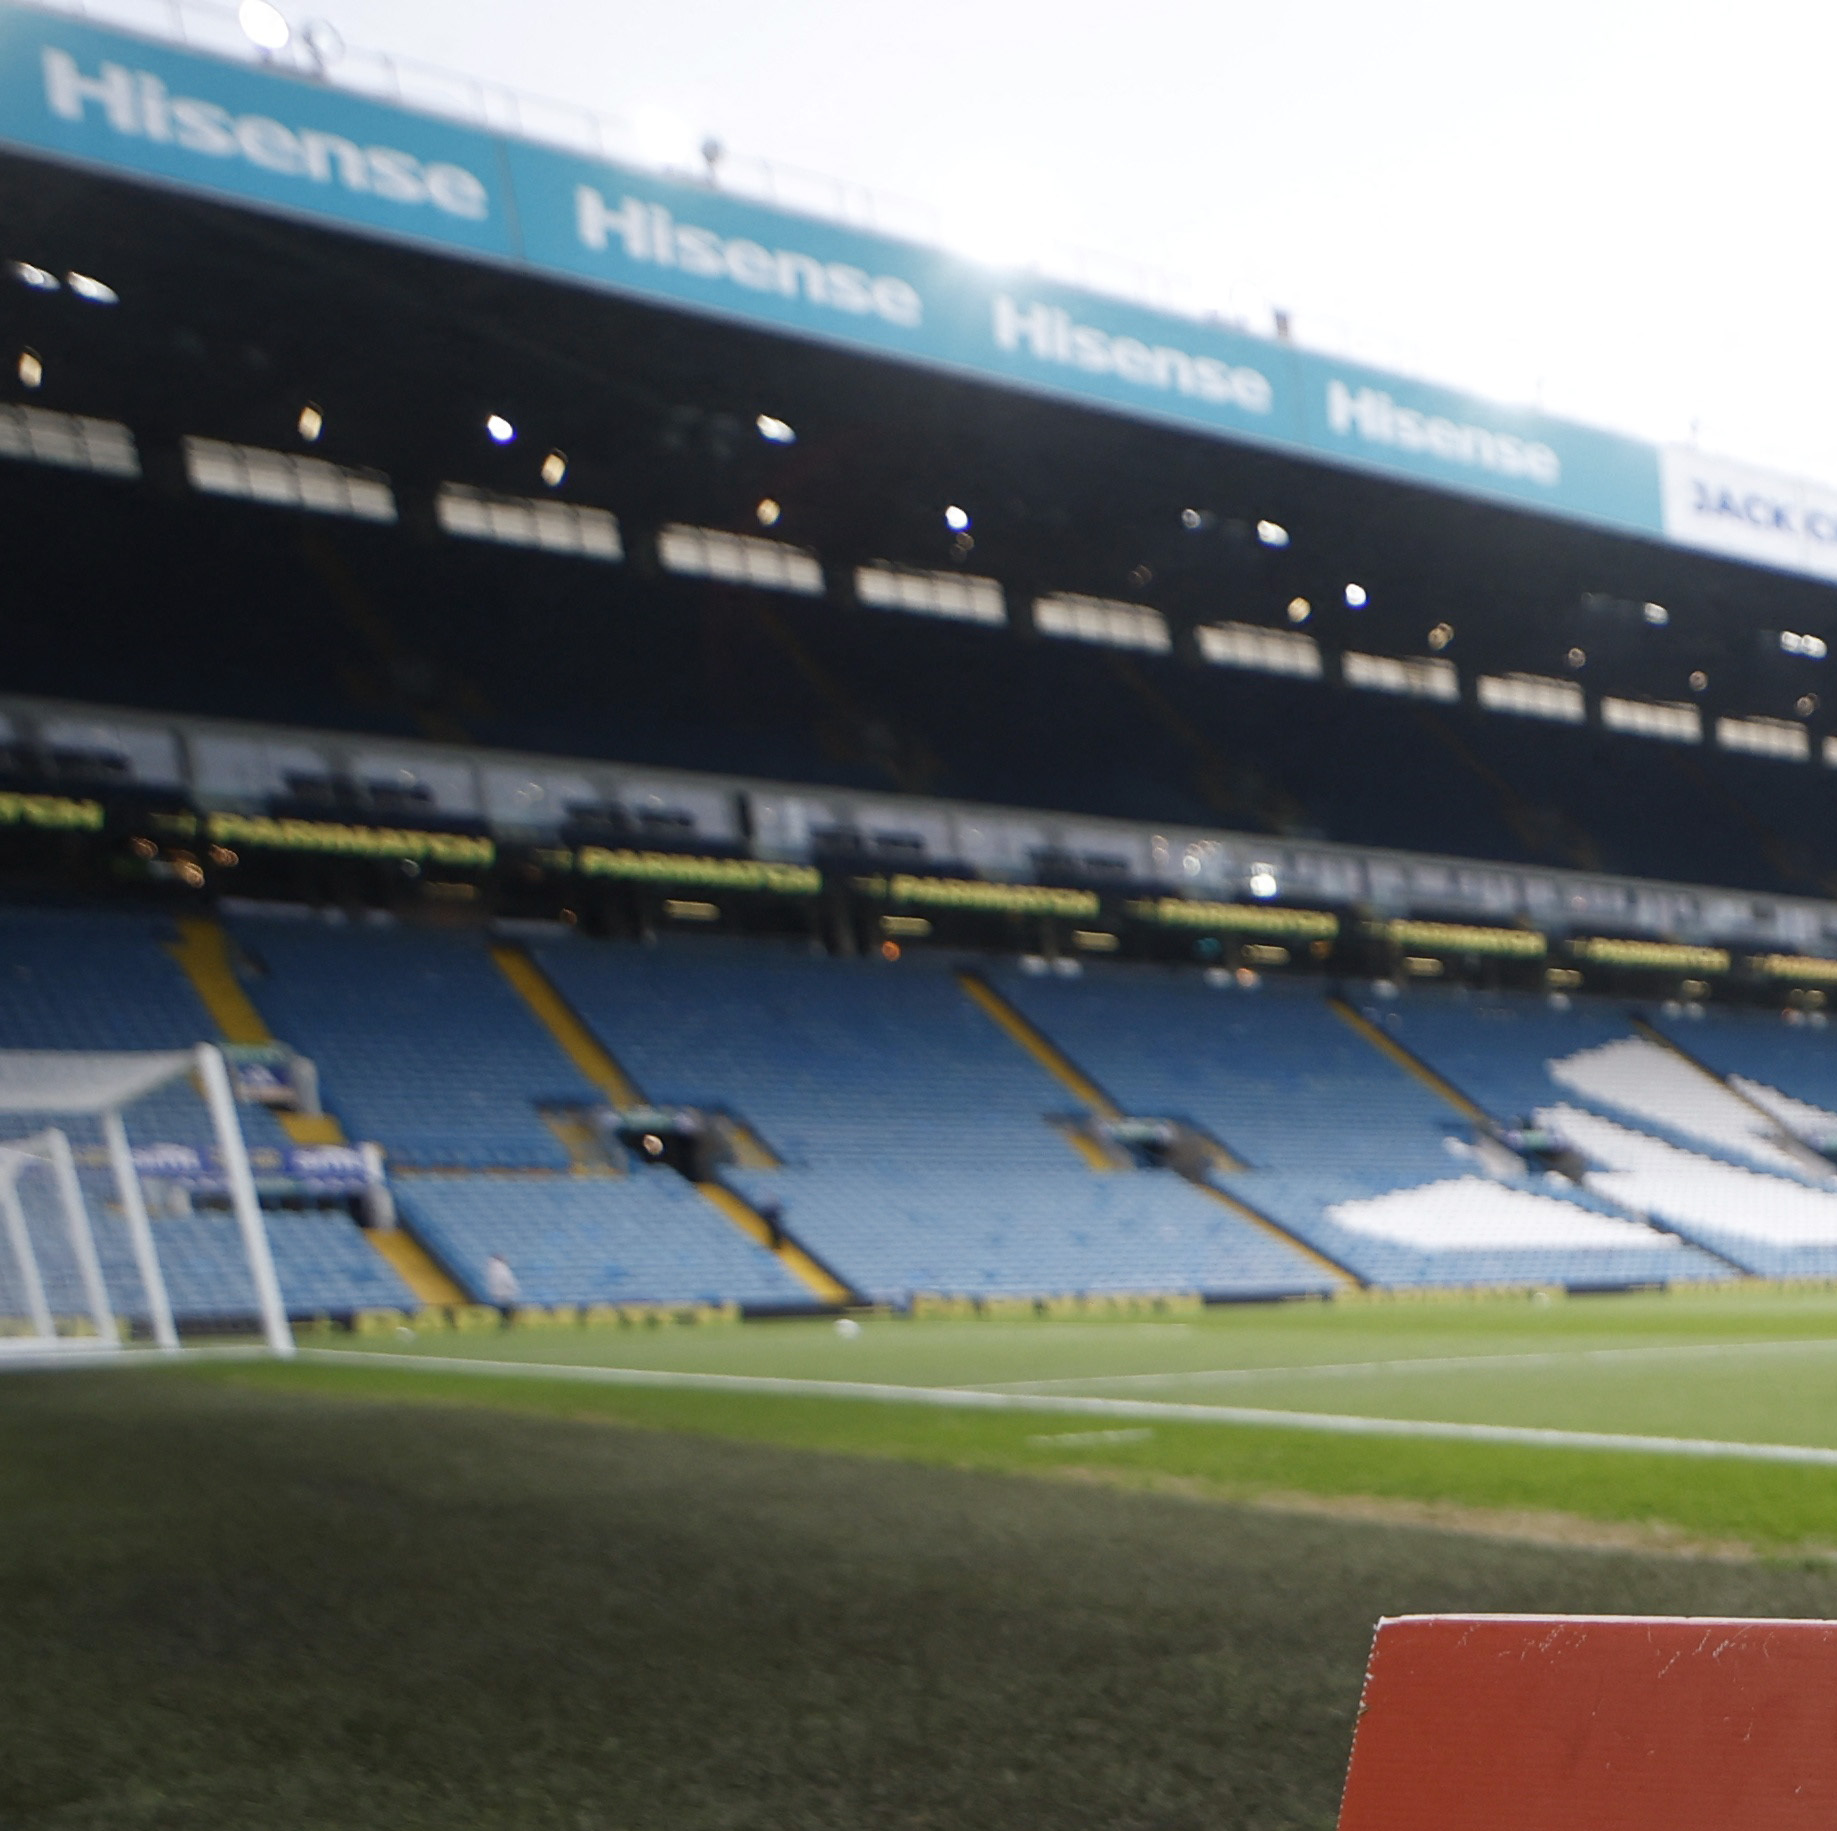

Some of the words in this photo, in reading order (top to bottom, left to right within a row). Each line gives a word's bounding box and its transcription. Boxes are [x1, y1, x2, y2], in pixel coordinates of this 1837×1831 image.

[42, 45, 488, 220] Hisense
[576, 184, 922, 328] Hisense
[992, 294, 1273, 414] Hisense
[1327, 379, 1561, 485] Hisense
[1693, 479, 1793, 532] JACK
